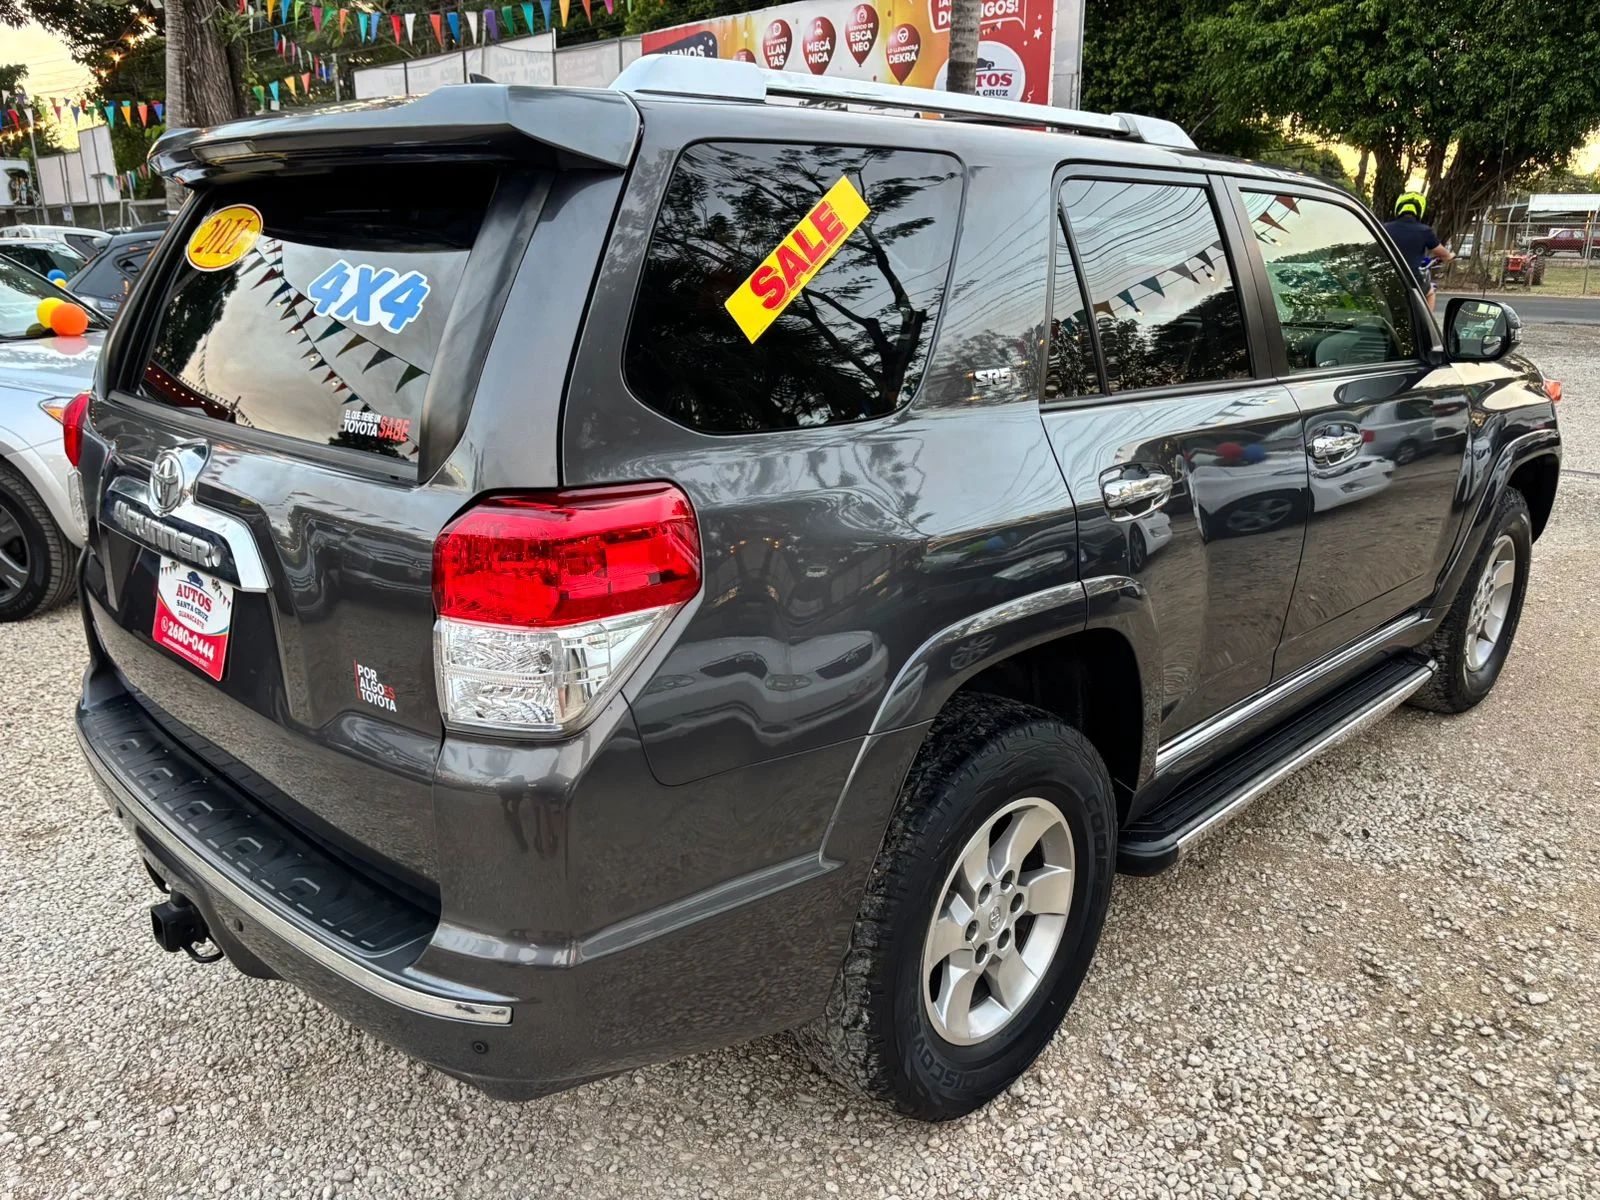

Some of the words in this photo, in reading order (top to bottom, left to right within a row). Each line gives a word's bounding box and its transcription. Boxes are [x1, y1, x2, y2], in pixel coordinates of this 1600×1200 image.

[850, 30, 872, 42] ESCA
[767, 43, 786, 56] LLAN
[807, 37, 830, 52] MECÁ
[852, 41, 869, 52] NEO
[769, 55, 784, 67] TAS
[809, 52, 829, 64] NICA
[888, 51, 917, 64] DEKRA
[983, 89, 1008, 97] CRUZ
[750, 201, 848, 310] SALE
[308, 260, 430, 333] 4X4
[345, 409, 351, 419] EL
[351, 410, 361, 420] QUE
[361, 411, 375, 423] TIENE
[343, 419, 378, 437] TOYOTA
[378, 416, 410, 442] SABE
[176, 583, 212, 612] AUTOS
[176, 600, 194, 612] SANTA
[194, 606, 209, 622] CRUZ
[168, 621, 215, 661] 2680-0444
[357, 664, 377, 682] POR
[360, 677, 384, 695] ALGO
[383, 685, 396, 700] ES
[360, 689, 397, 712] TOYOTA
